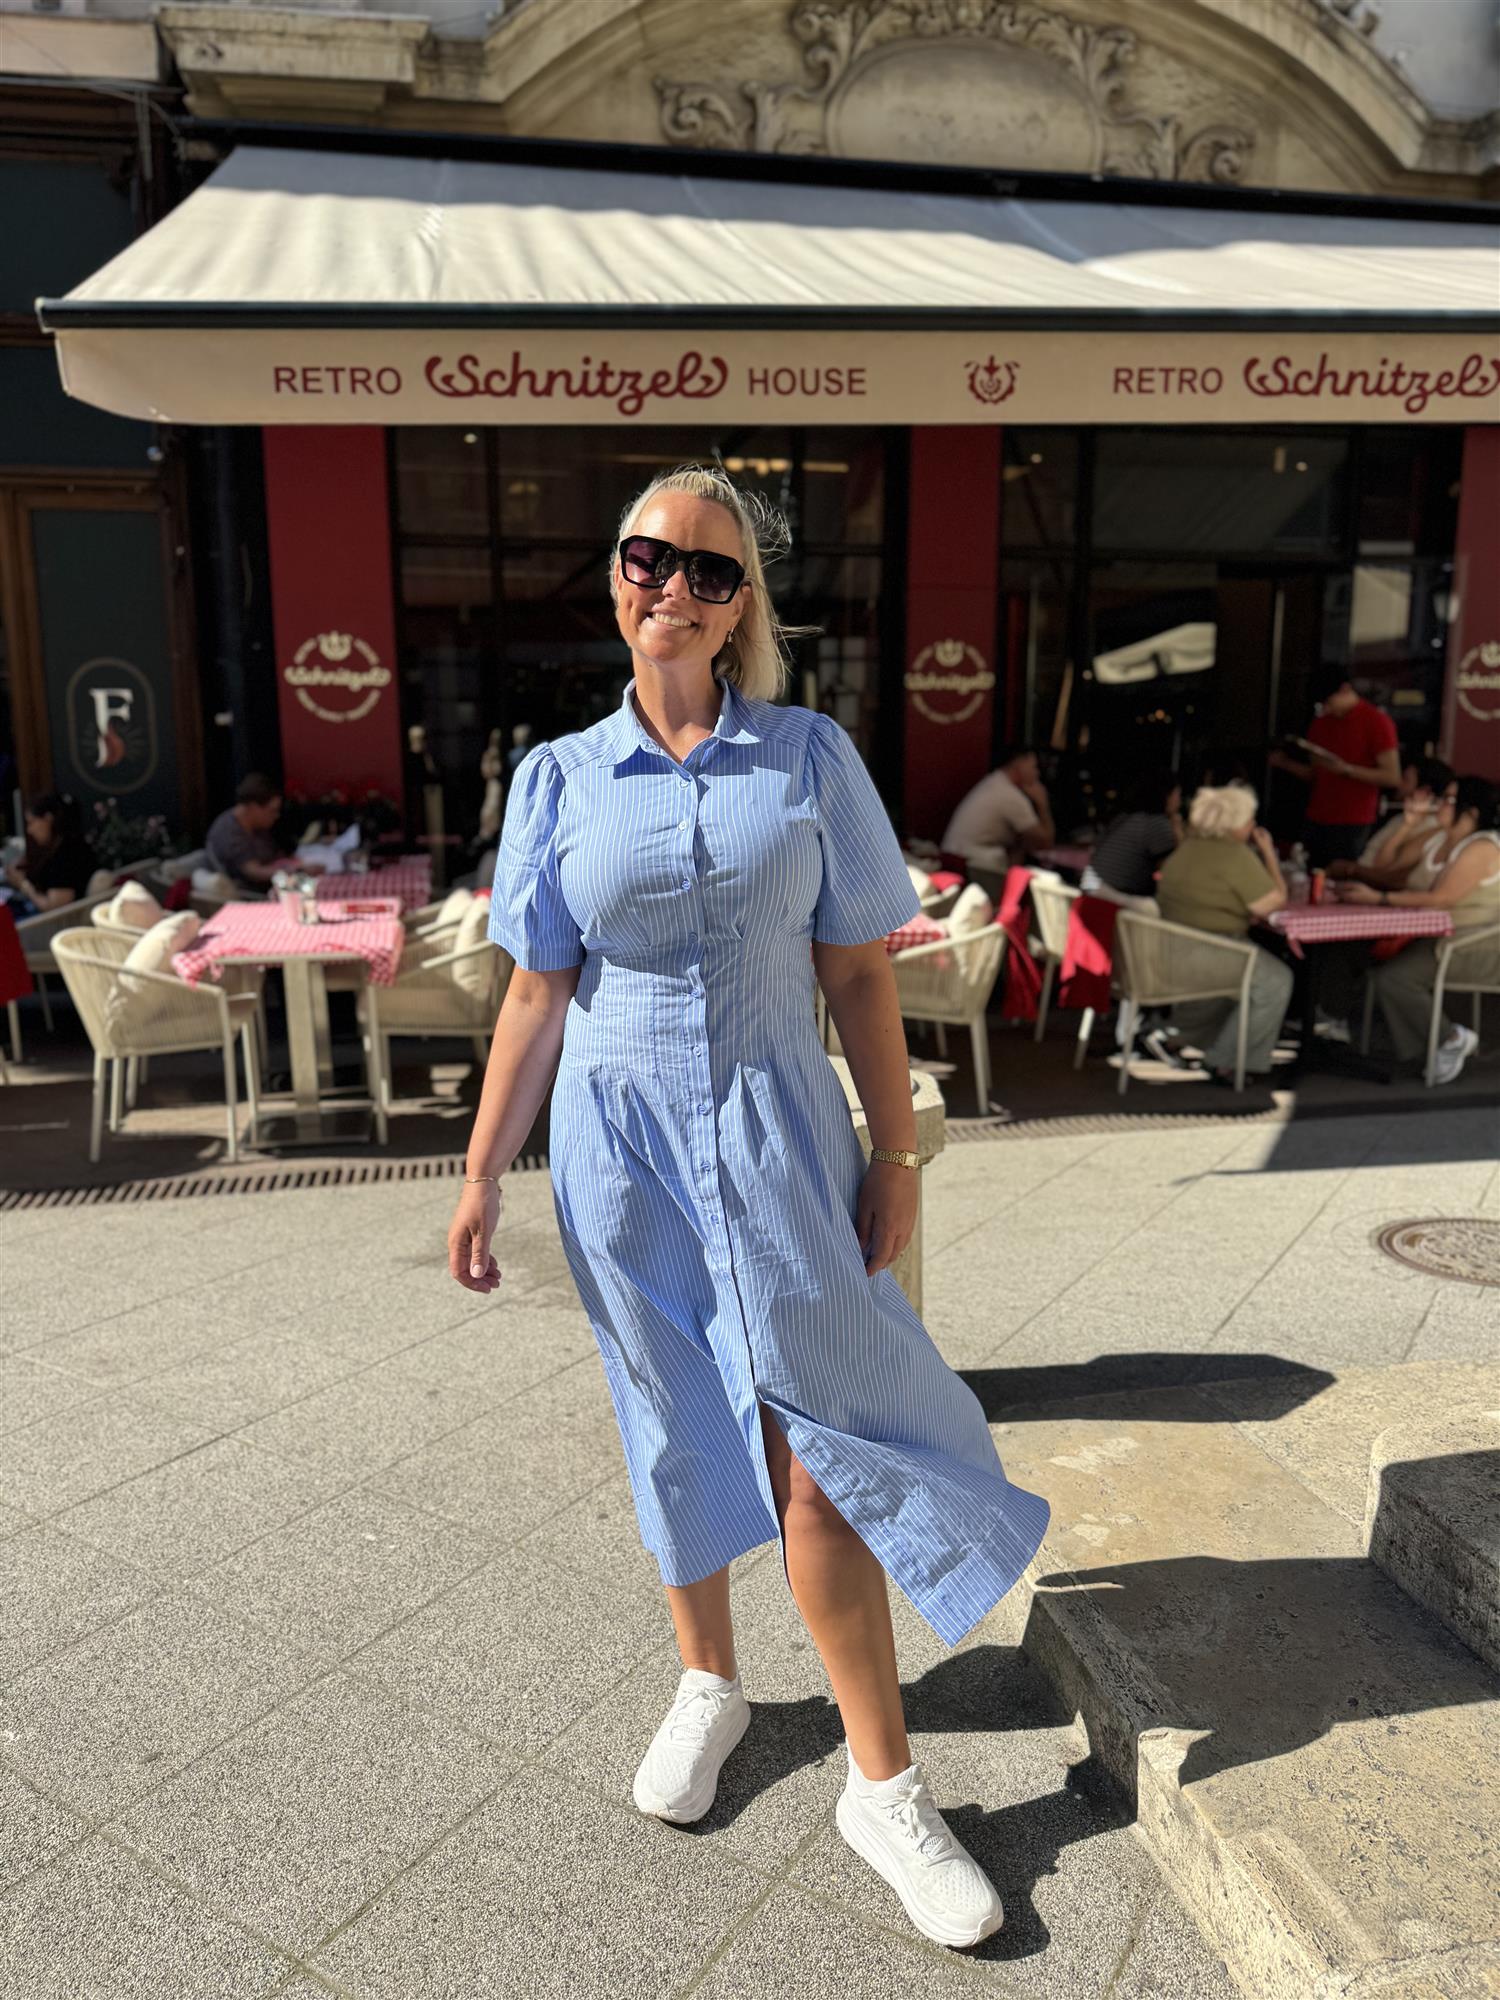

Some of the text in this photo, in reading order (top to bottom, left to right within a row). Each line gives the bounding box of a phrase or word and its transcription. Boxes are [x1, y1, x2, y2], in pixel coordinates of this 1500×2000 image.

[273, 350, 867, 416] RETRO Schnitzel HOUSE
[1113, 352, 1500, 415] RETRO Schnitzel
[89, 688, 134, 768] F
